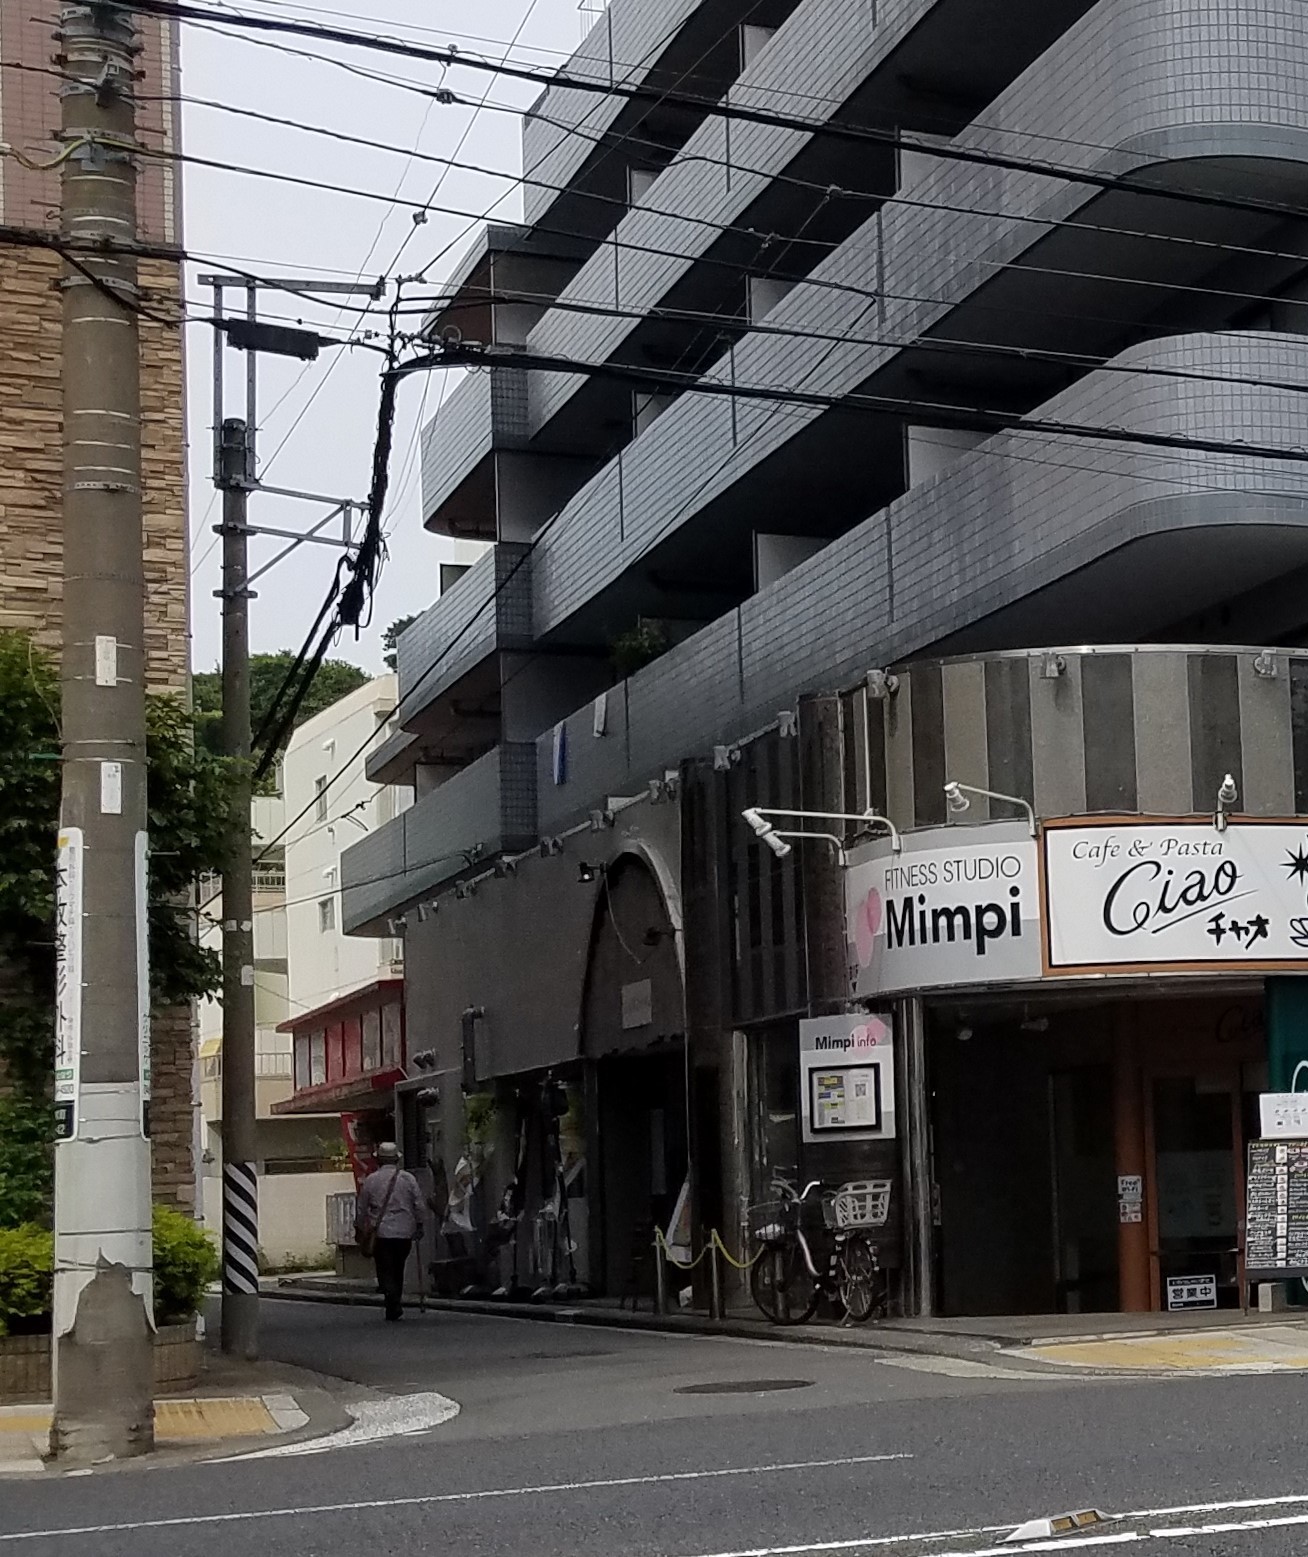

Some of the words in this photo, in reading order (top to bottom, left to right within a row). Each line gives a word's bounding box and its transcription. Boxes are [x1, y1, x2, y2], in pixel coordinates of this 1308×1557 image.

[1072, 835, 1121, 868] Cafe
[1128, 839, 1154, 856] &
[1160, 838, 1224, 856] Pasta
[884, 861, 938, 891] FITNESS
[943, 855, 1021, 883] STUDIO
[1103, 859, 1245, 936] Ciao
[886, 885, 1022, 956] Mimpi
[1206, 911, 1270, 950] チャオ
[815, 1033, 855, 1052] Mimpi
[1172, 1286, 1213, 1300] 営業中
